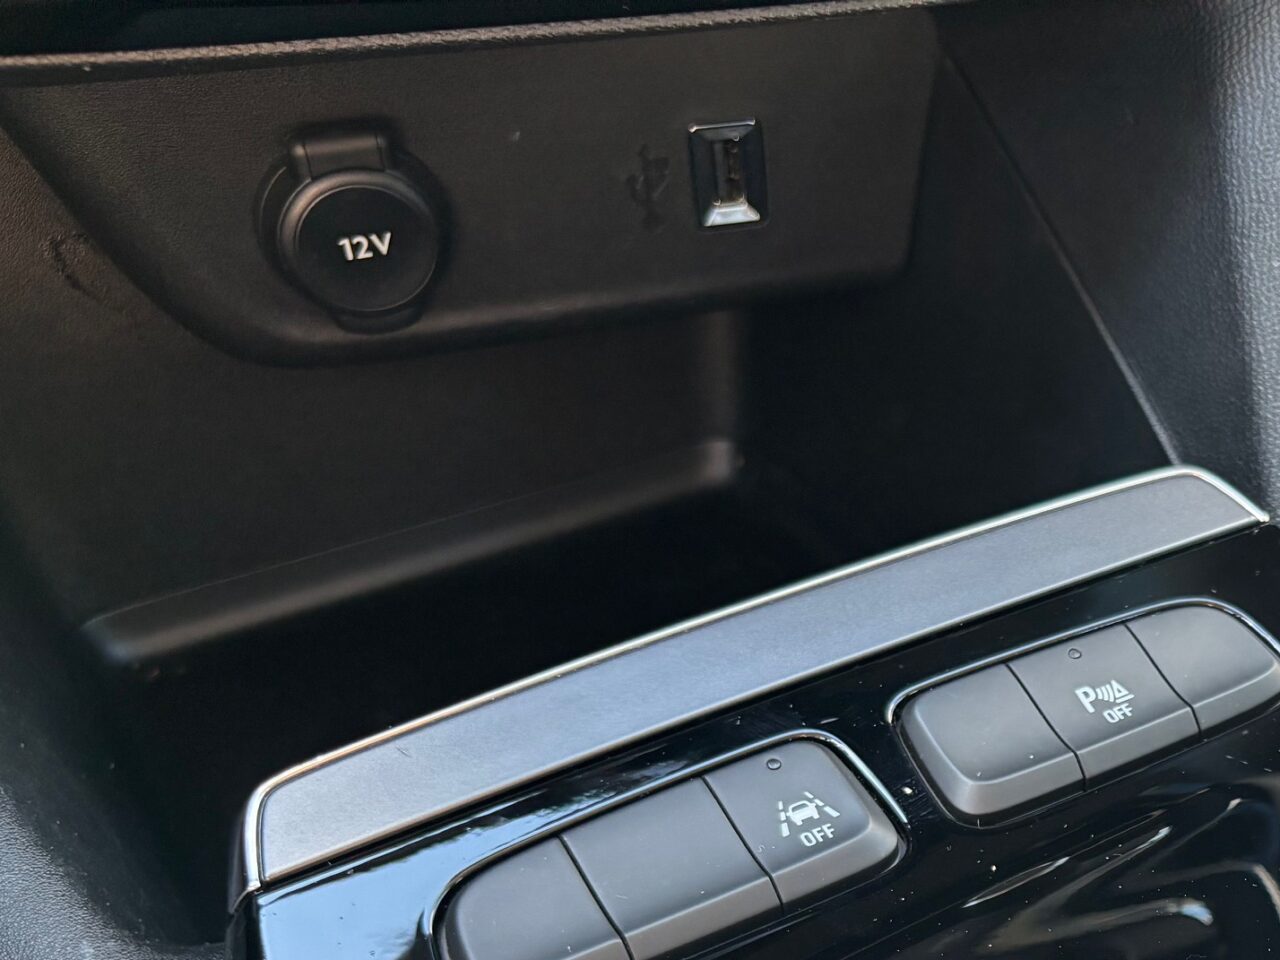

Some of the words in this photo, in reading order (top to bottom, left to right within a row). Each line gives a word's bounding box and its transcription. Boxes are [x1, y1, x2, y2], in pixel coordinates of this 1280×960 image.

[337, 231, 392, 261] 12V
[1074, 685, 1097, 714] P
[1102, 702, 1133, 724] OFF
[800, 823, 835, 847] OFF
